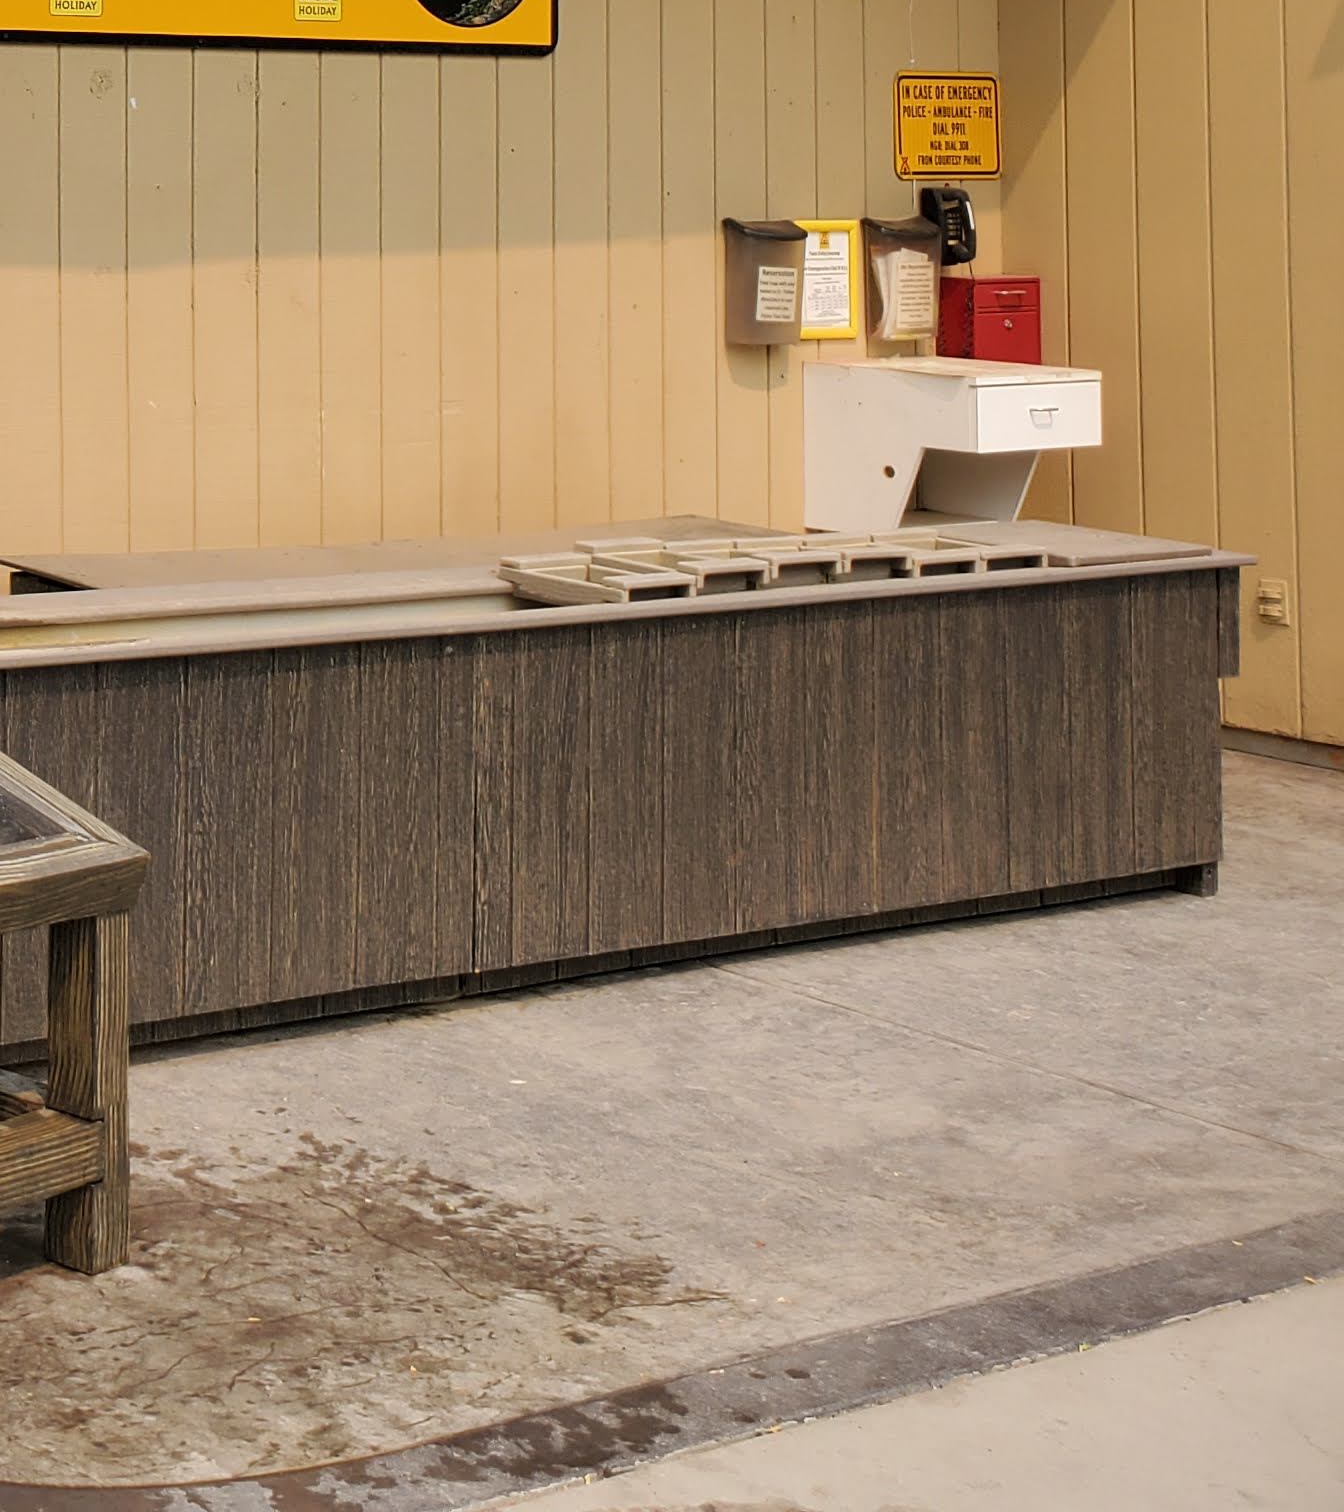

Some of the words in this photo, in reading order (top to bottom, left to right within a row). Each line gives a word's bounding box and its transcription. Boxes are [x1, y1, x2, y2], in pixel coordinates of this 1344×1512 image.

[54, 0, 98, 11] HOLIDAY
[298, 4, 337, 17] HOLIDAY
[902, 85, 910, 99] IN
[913, 85, 933, 100] CASE
[935, 85, 945, 100] OF
[947, 86, 993, 101] EMERGENCY
[903, 106, 926, 118] POLICE
[933, 106, 972, 119] AMBULANCE
[979, 106, 993, 119] FIRE
[933, 122, 949, 136] DIAL
